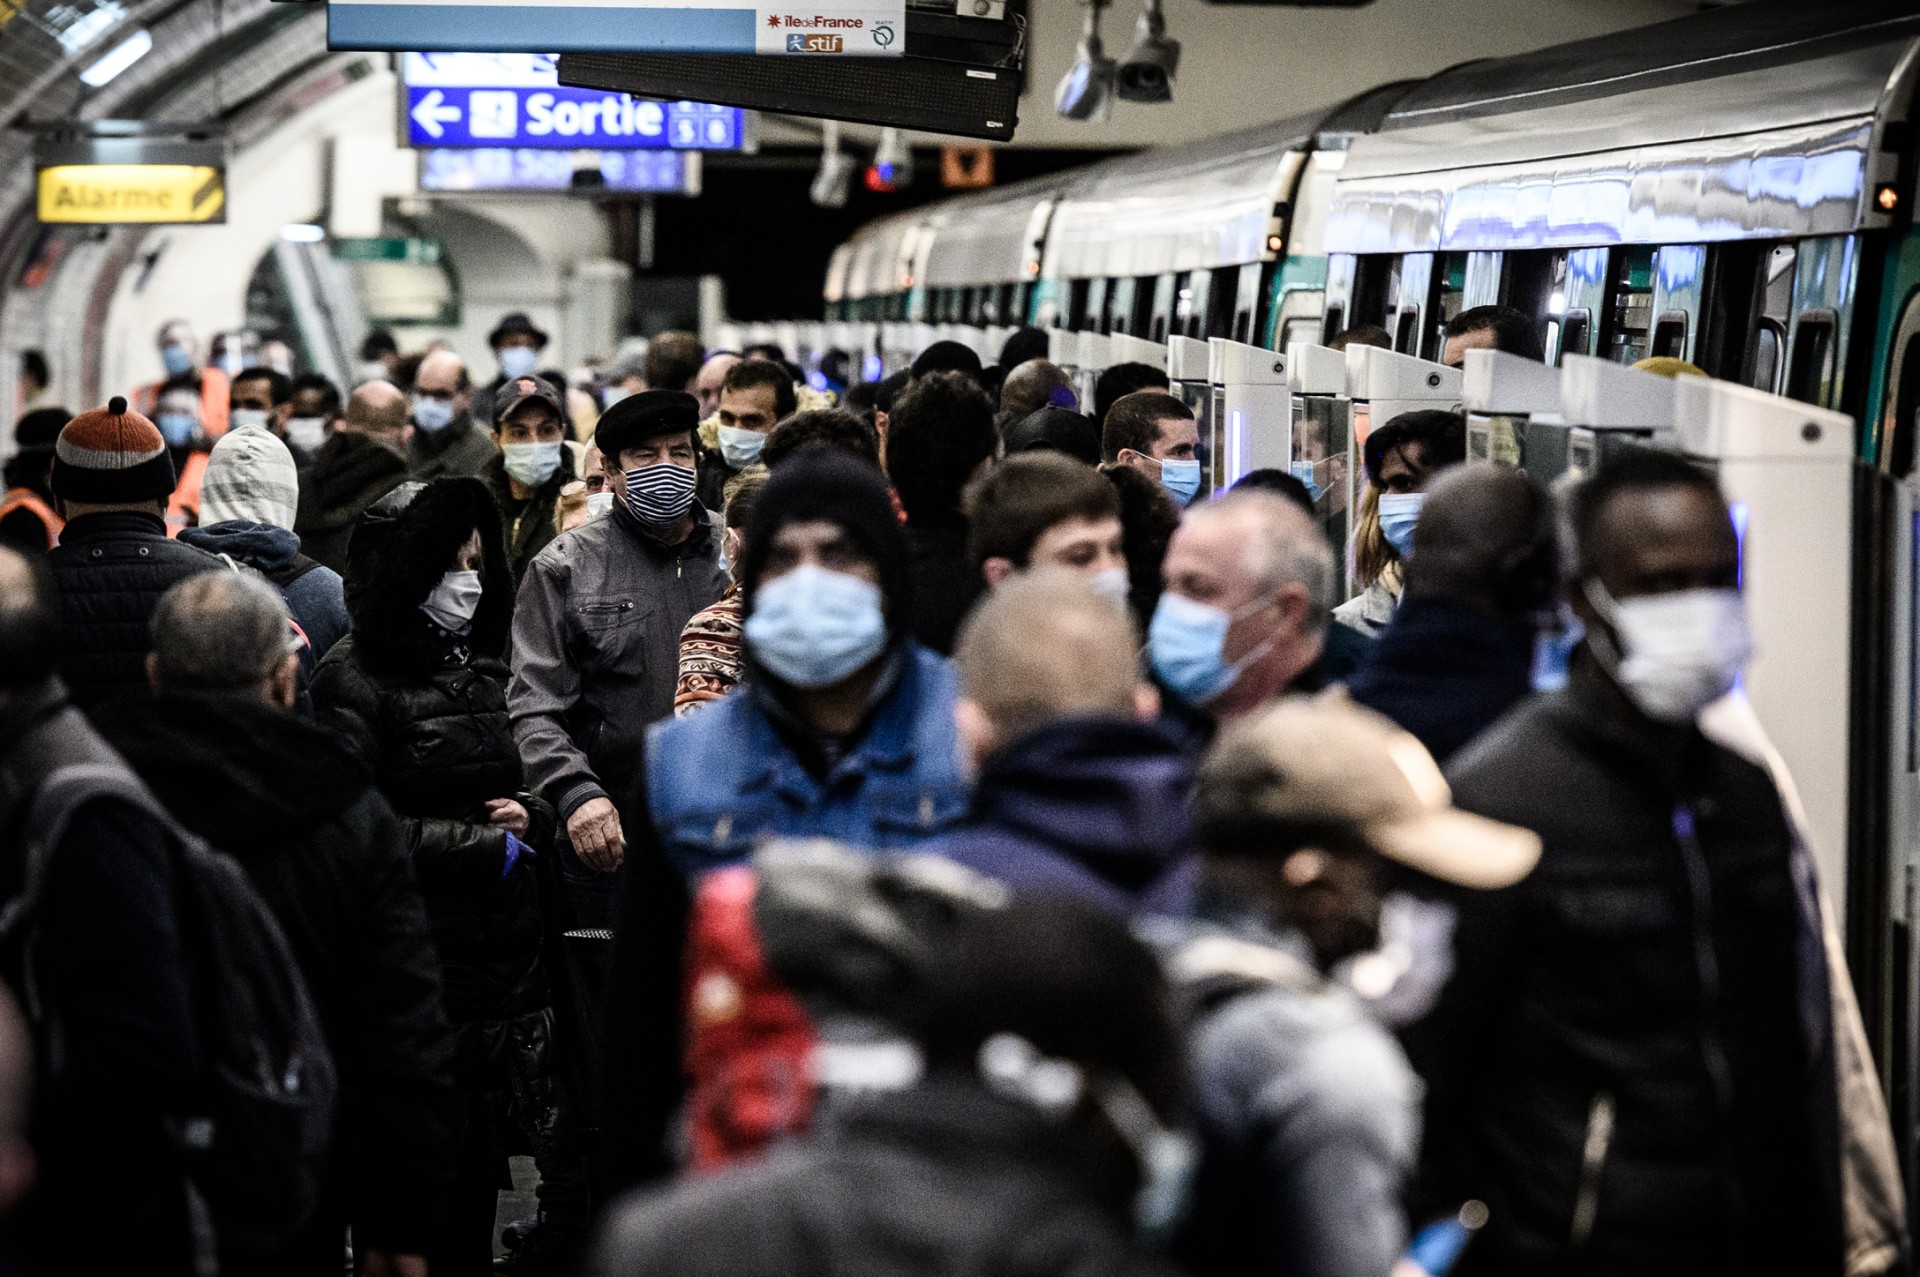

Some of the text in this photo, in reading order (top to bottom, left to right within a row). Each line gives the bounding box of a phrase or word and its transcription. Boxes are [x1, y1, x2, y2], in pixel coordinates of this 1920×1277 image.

[807, 35, 843, 51] stif
[525, 92, 664, 136] Sortie
[55, 185, 172, 209] Alarme
